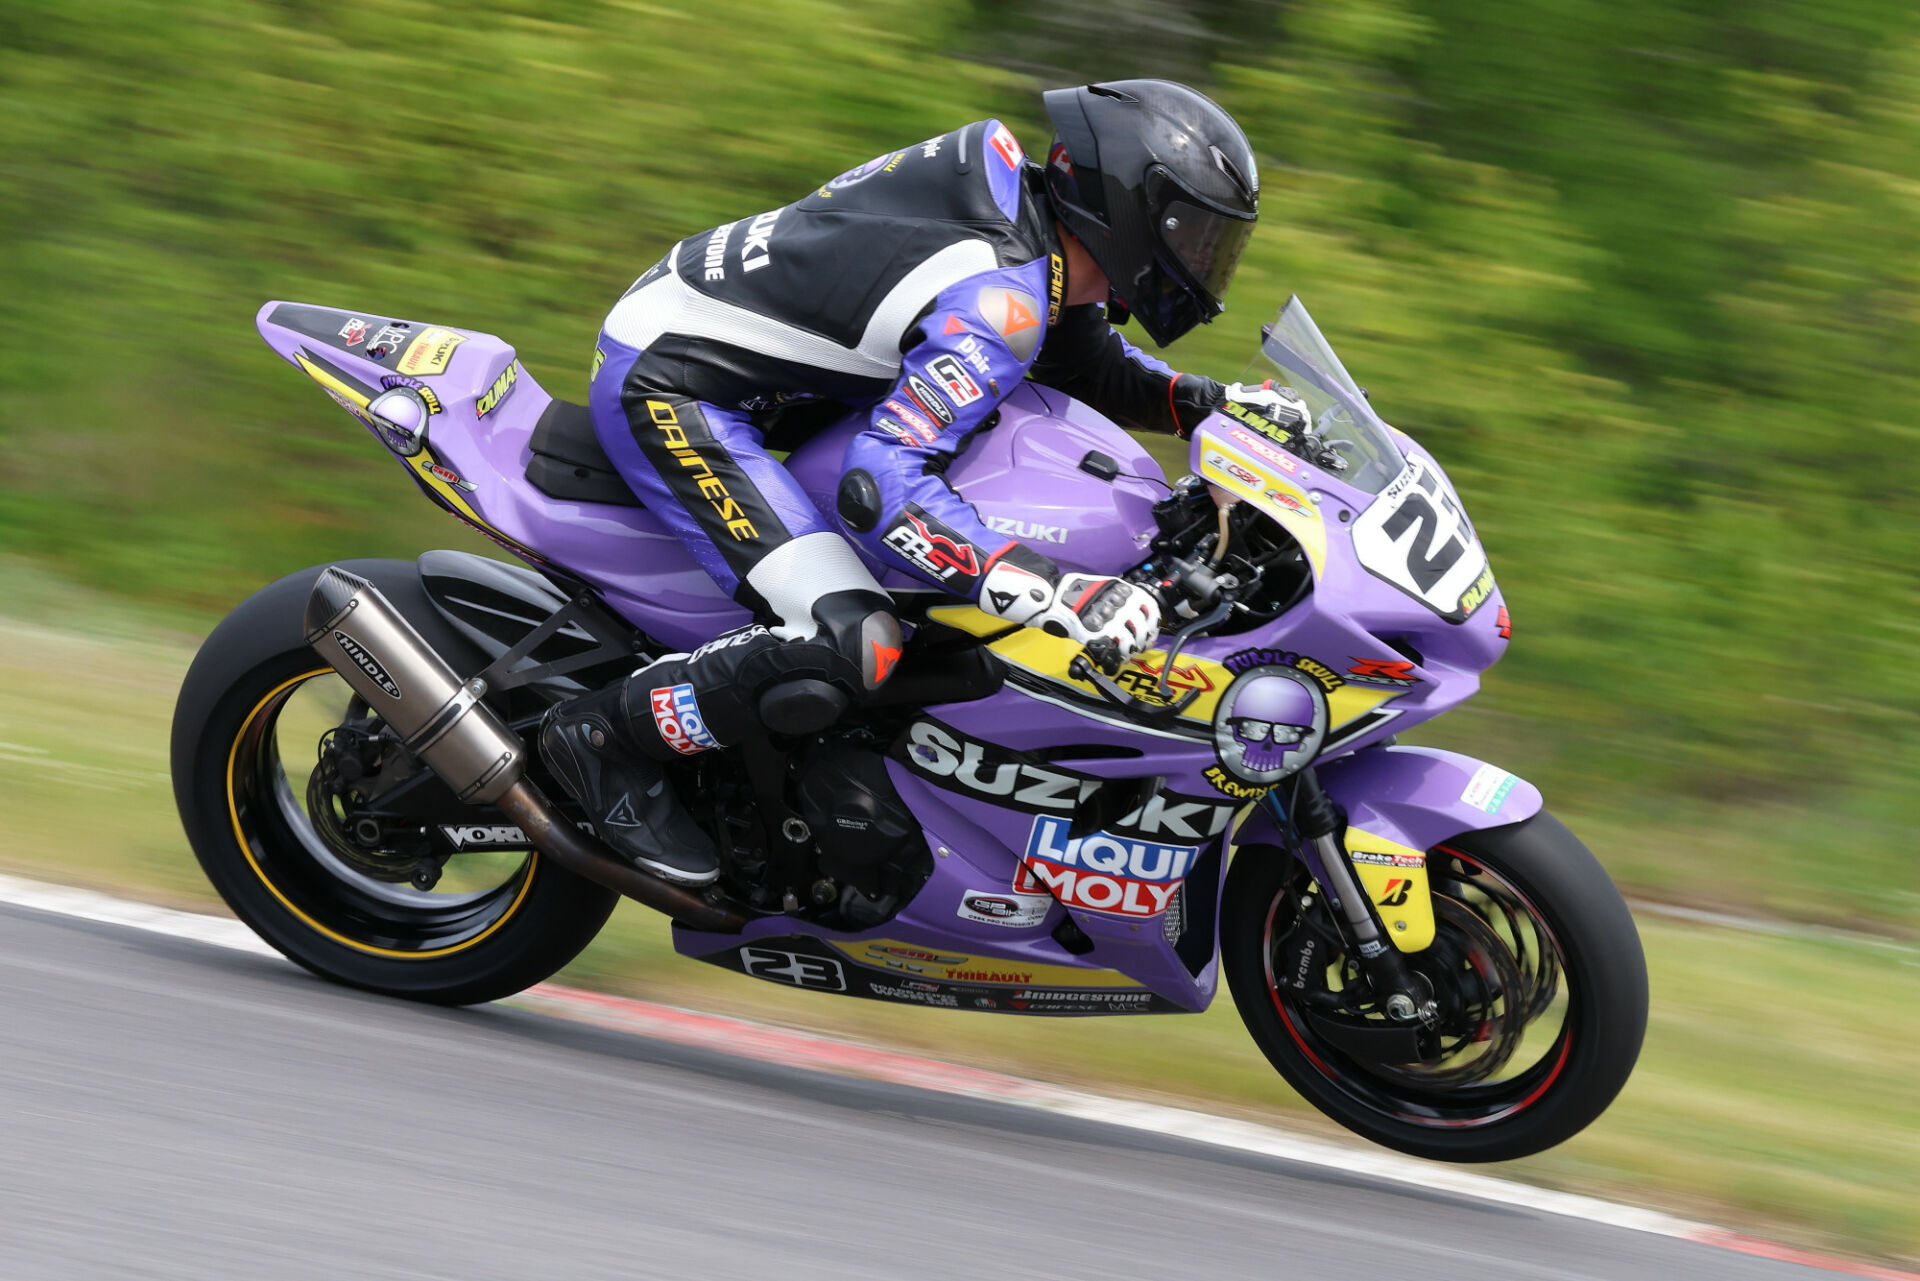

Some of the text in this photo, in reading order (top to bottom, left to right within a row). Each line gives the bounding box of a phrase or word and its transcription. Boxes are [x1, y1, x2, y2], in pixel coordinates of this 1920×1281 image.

[417, 386, 441, 415] SKULL
[1222, 400, 1292, 444] DUMAS
[646, 399, 760, 541] DAINESE
[979, 515, 1068, 545] ZUKI
[340, 637, 396, 692] HINDLE
[1227, 652, 1295, 674] PURPLE
[1296, 658, 1344, 693] SKULL
[652, 692, 708, 753] MOLY
[1036, 821, 1190, 881] LIQUI
[1024, 863, 1183, 914] MOLY
[748, 948, 843, 989] 23
[945, 968, 1033, 984] THIBAULT
[1293, 940, 1316, 990] brembo
